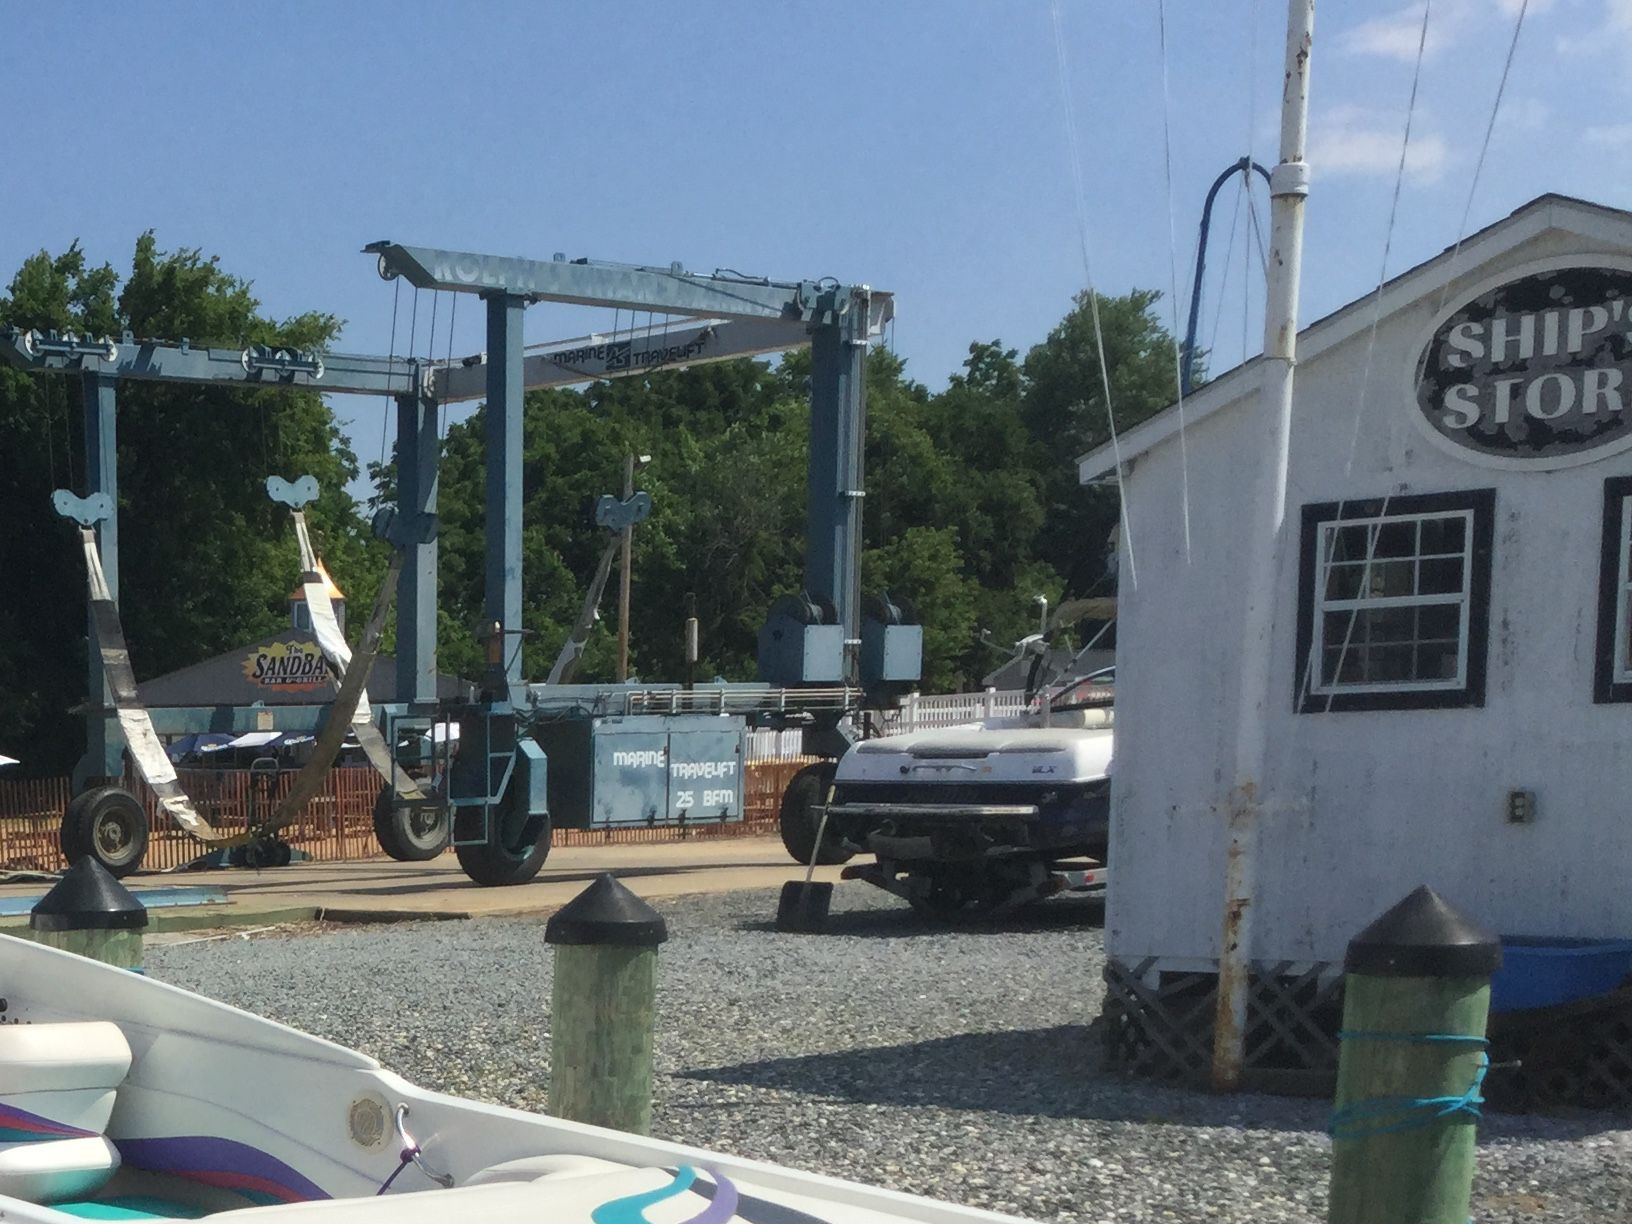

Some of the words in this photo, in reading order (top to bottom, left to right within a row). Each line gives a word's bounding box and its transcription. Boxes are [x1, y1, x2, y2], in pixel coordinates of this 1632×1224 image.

[1448, 299, 1632, 368] SHIP'
[553, 345, 605, 365] MARINE
[285, 644, 304, 655] The
[252, 653, 328, 679] SANDBA
[264, 676, 283, 685] BAR
[613, 749, 665, 769] MARINE
[671, 761, 737, 780] TRAVELIFT
[676, 790, 694, 809] 25
[703, 788, 734, 807] BFM
